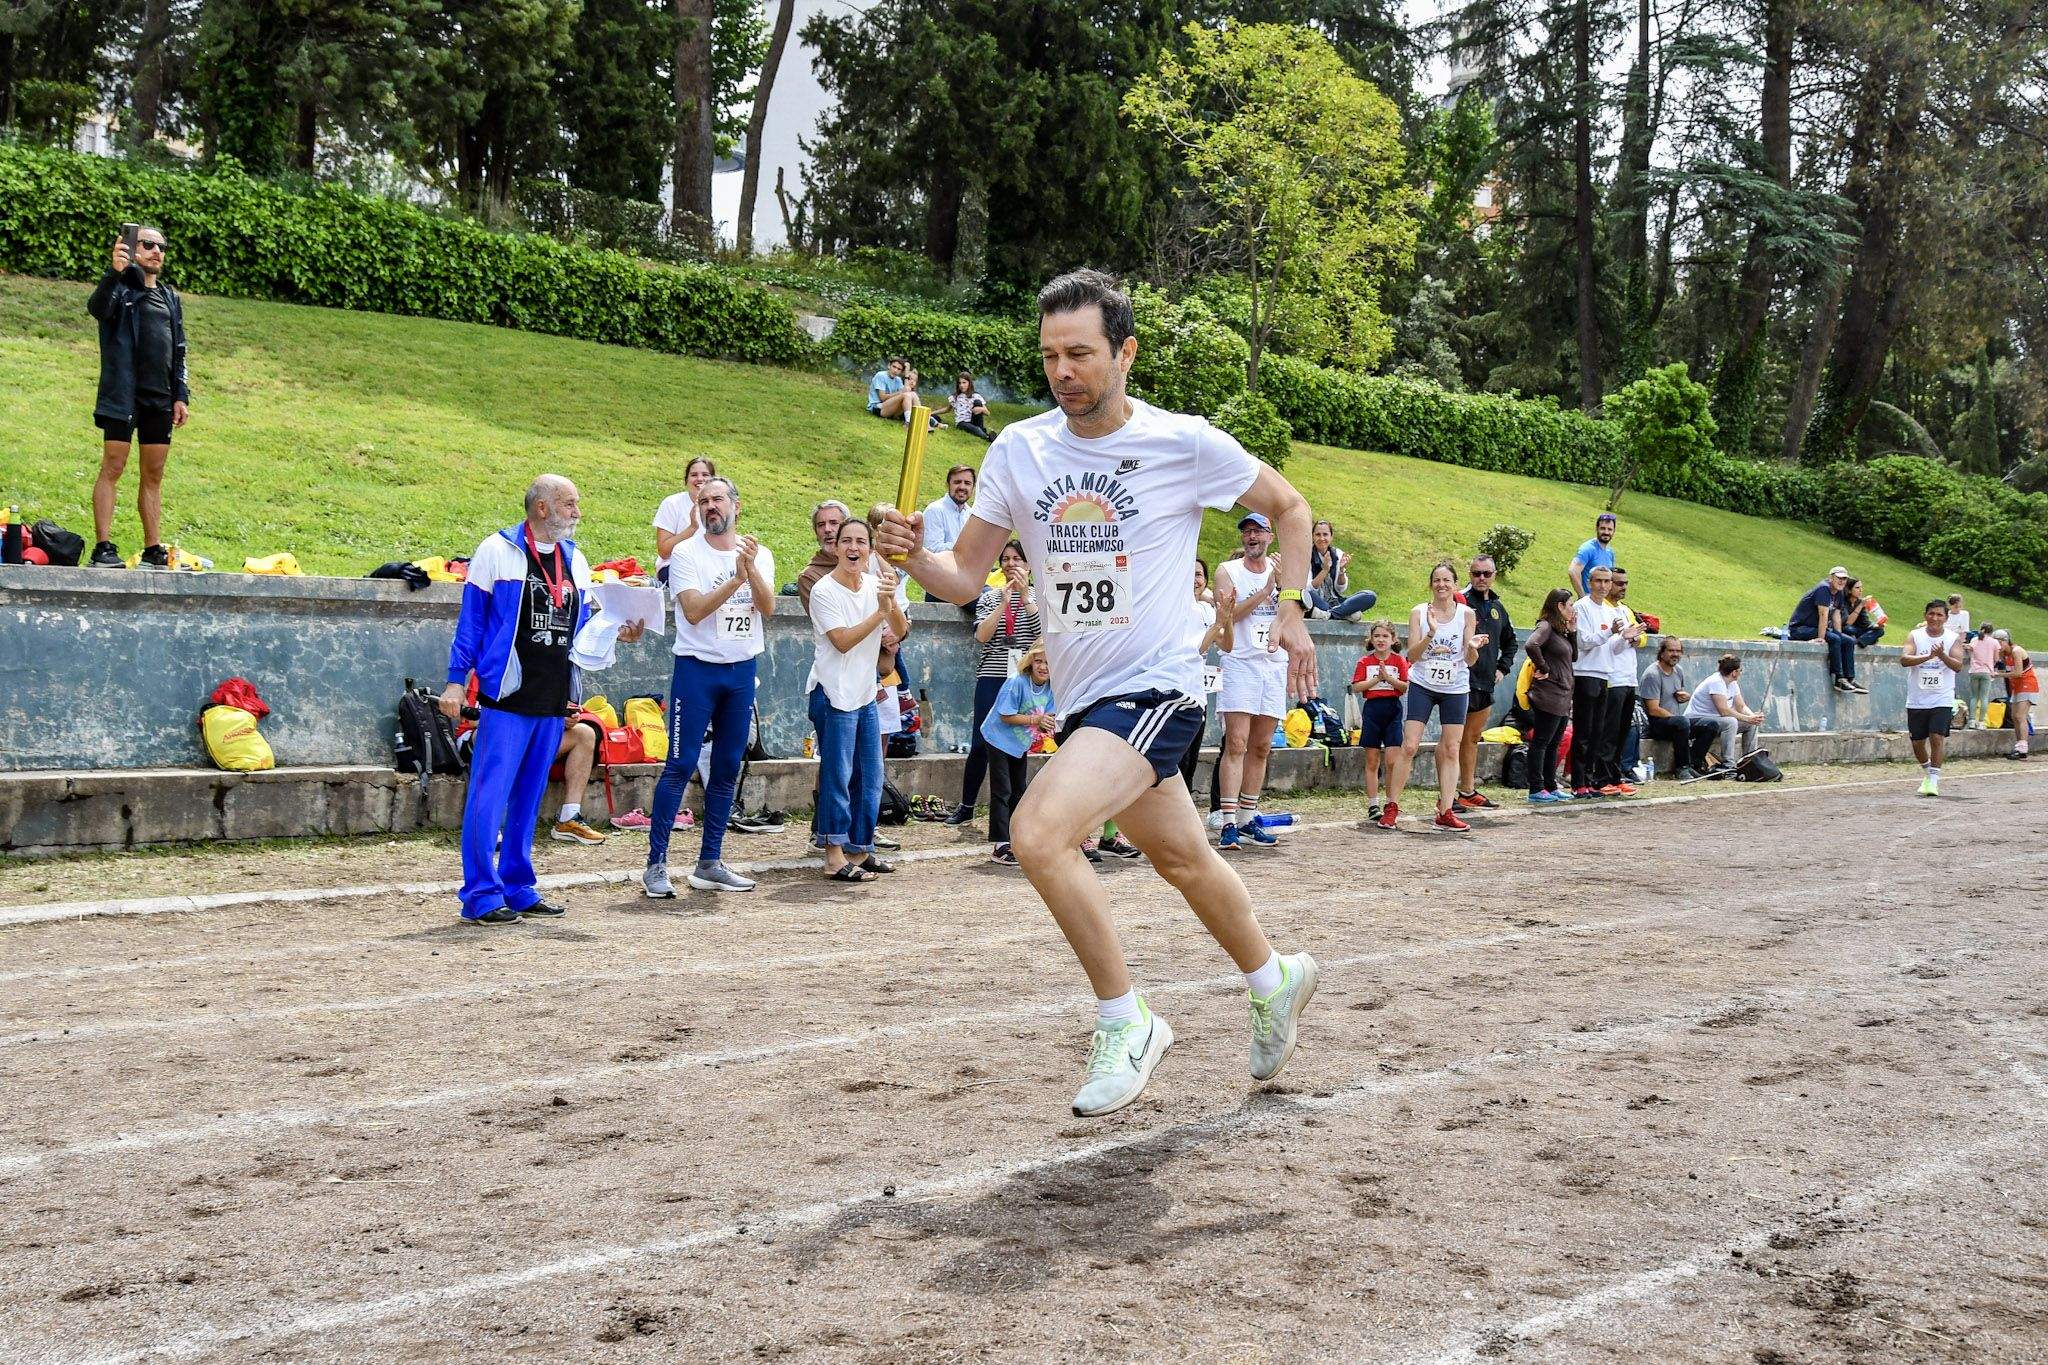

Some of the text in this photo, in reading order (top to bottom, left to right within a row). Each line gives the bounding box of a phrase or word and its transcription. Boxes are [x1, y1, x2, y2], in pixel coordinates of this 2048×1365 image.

[1119, 459, 1141, 470] NIKE
[1033, 471, 1140, 522] SANTA MONICA
[1049, 524, 1119, 538] TRACK CLUB
[1045, 539, 1124, 554] VALLEHERMOSO
[1055, 579, 1115, 614] 738
[725, 616, 751, 632] 729
[1109, 616, 1130, 625] 2023
[1430, 668, 1452, 680] 751
[1922, 676, 1939, 685] 728
[672, 714, 681, 759] MARATHON
